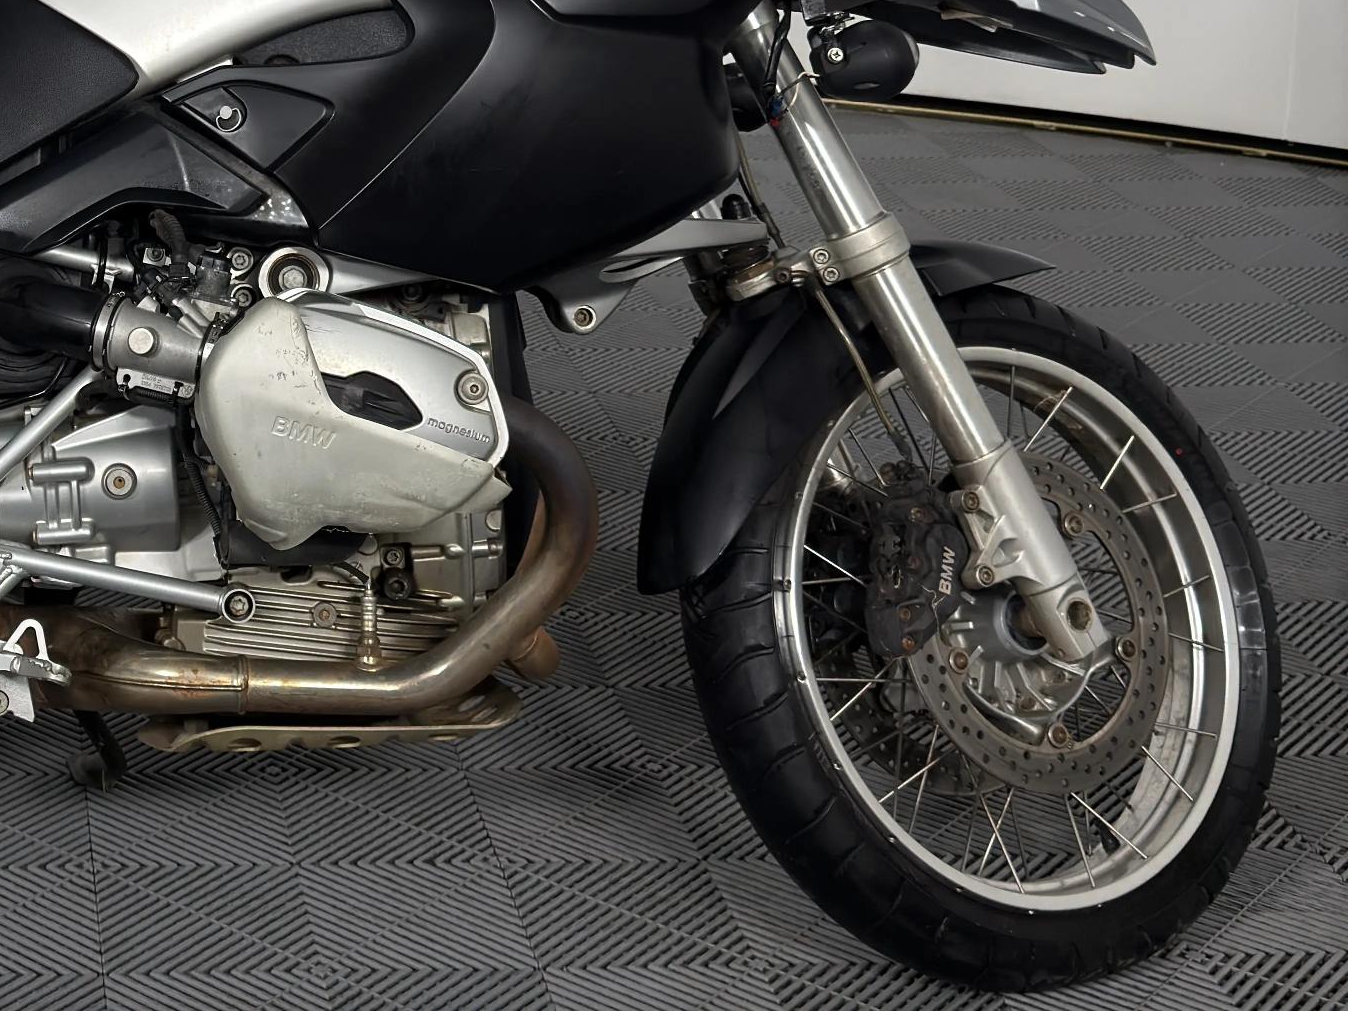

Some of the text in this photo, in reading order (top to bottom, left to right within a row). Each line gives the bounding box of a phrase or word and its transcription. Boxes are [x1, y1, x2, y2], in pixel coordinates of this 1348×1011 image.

[270, 416, 336, 449] BMW
[427, 417, 491, 444] magnesium
[939, 546, 956, 596] BMW
